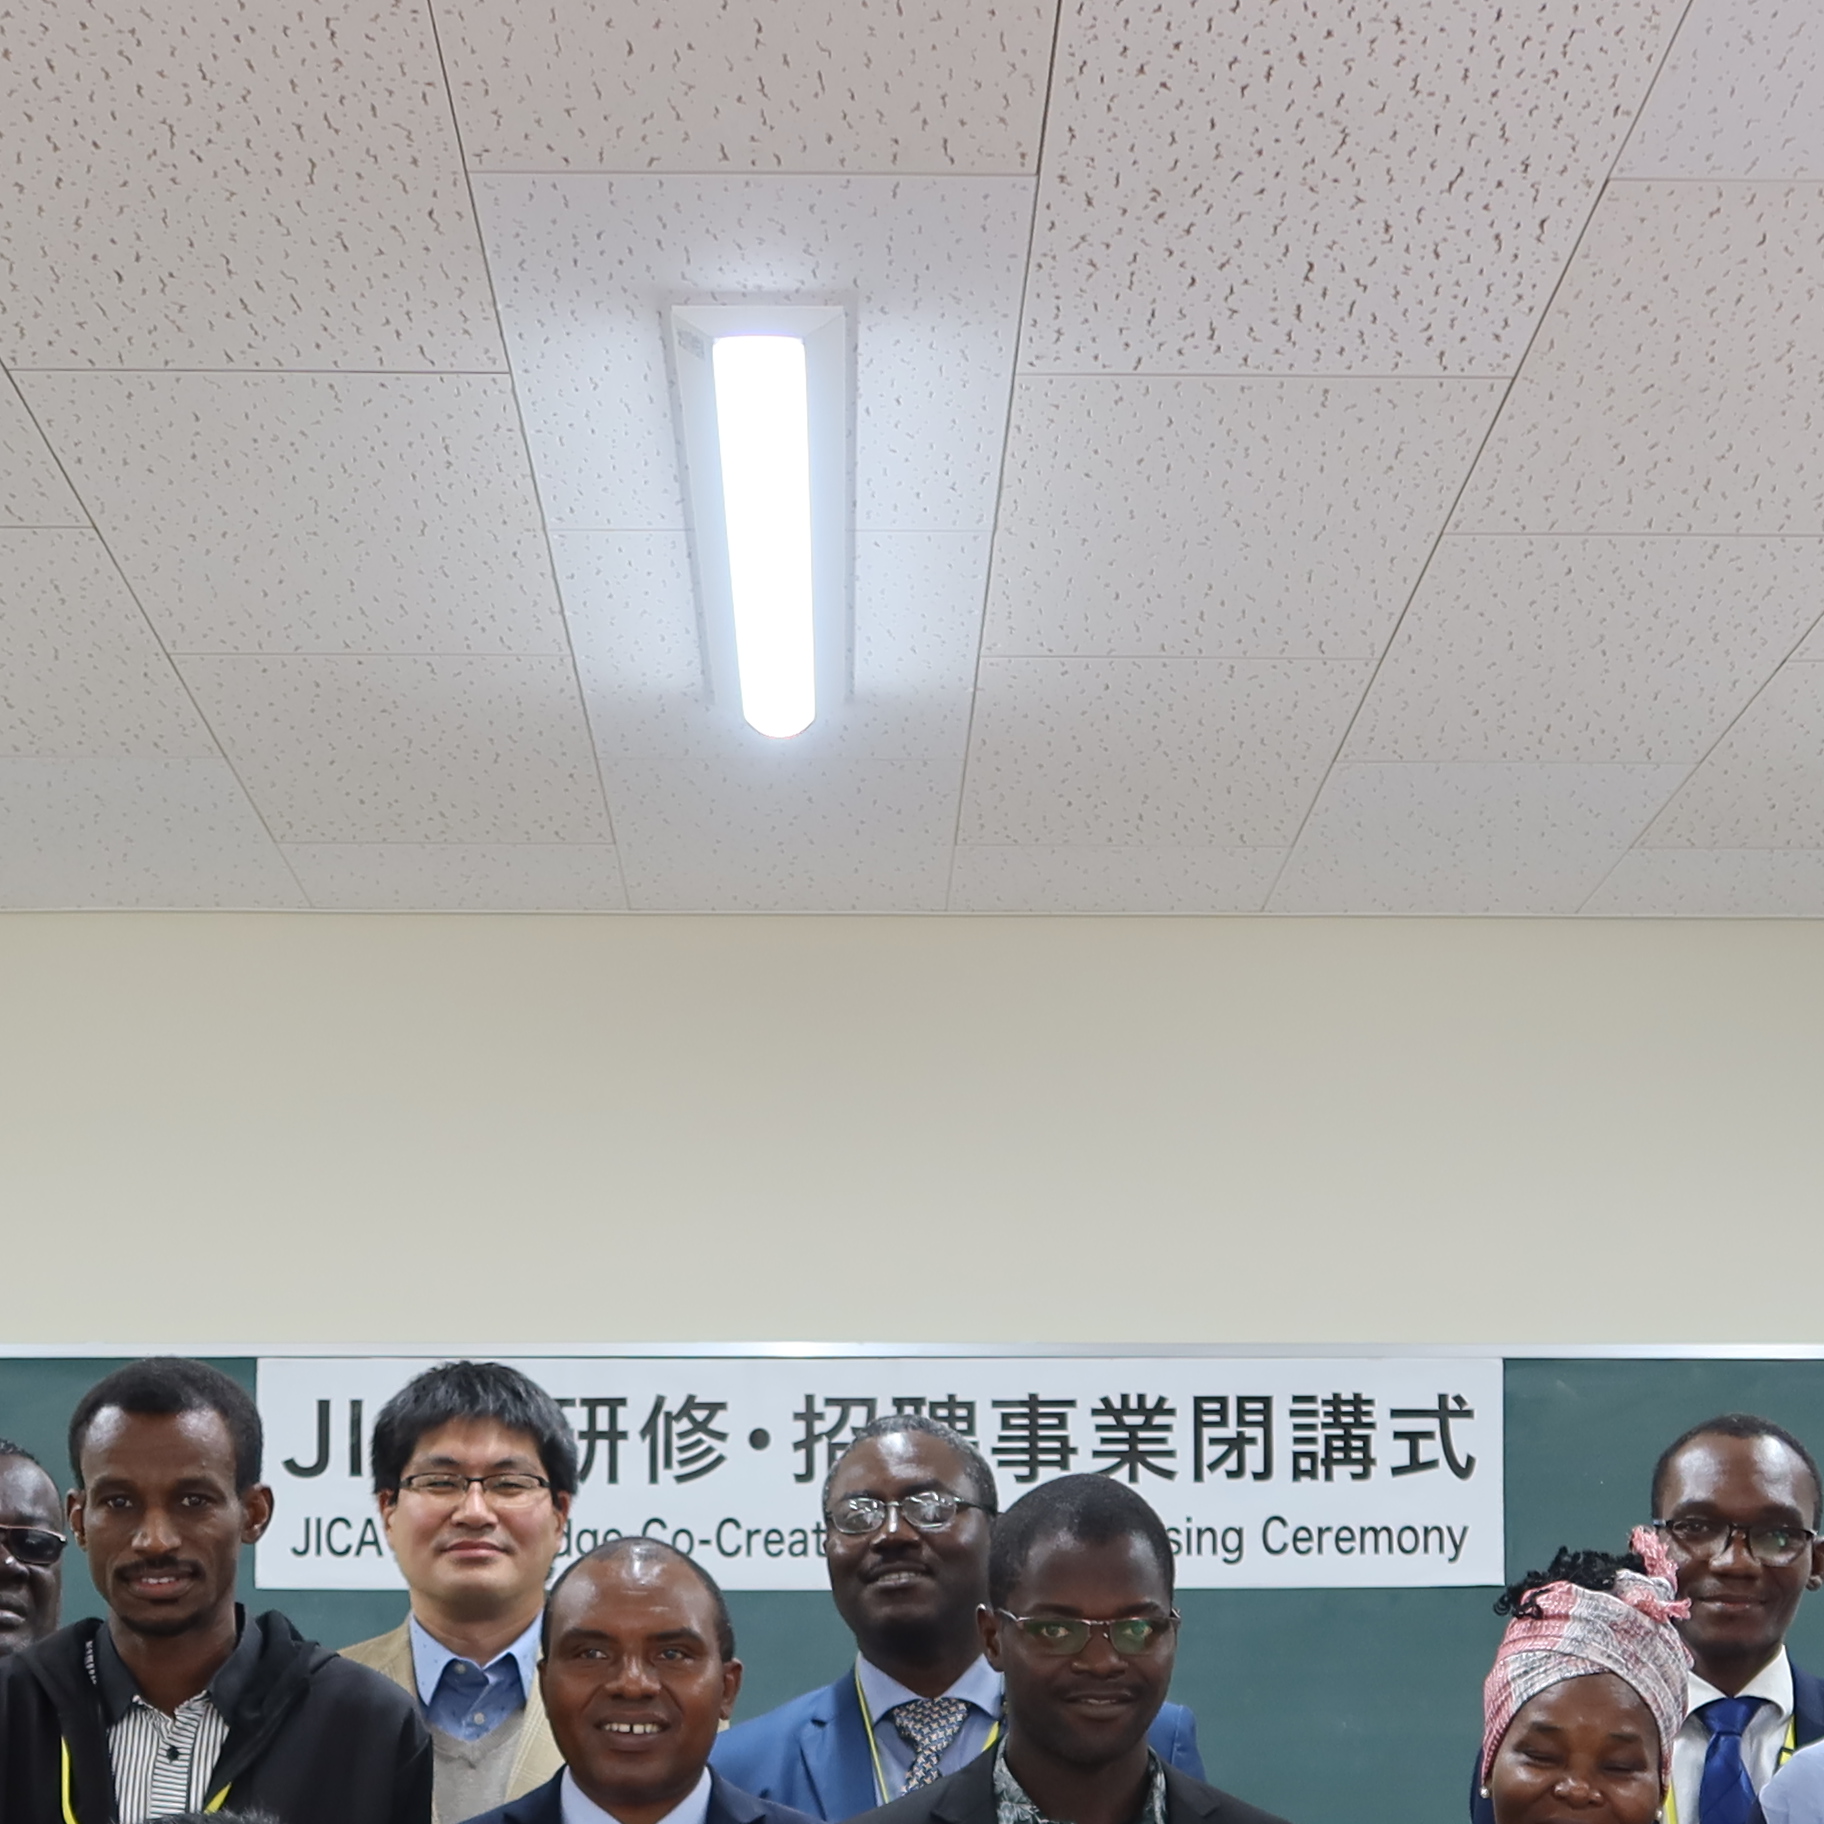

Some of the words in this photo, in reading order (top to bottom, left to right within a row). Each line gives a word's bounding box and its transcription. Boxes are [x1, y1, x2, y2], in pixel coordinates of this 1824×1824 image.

[291, 1517, 383, 1557] JICA
[1170, 1516, 1245, 1564] sing
[1262, 1515, 1469, 1564] Ceremony
